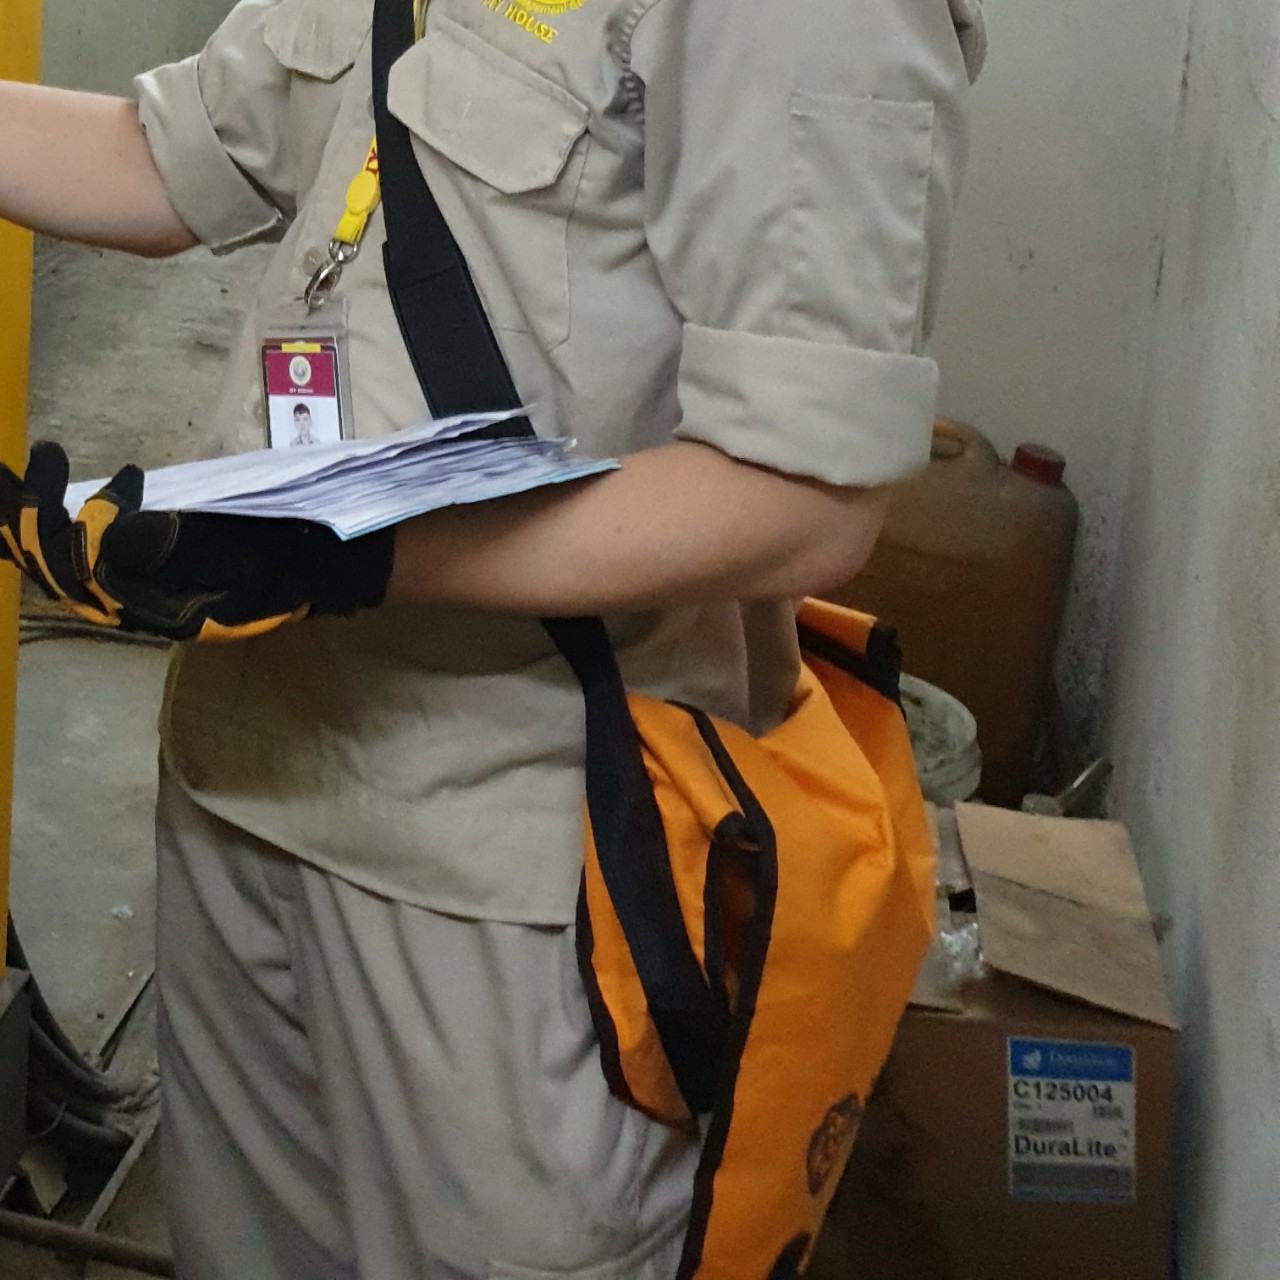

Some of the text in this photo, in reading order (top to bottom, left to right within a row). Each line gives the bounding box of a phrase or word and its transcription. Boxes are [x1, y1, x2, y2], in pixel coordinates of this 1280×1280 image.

[503, 3, 559, 44] HOUSE
[1013, 1079, 1113, 1103] C125004
[1014, 1133, 1118, 1158] DuraLite
